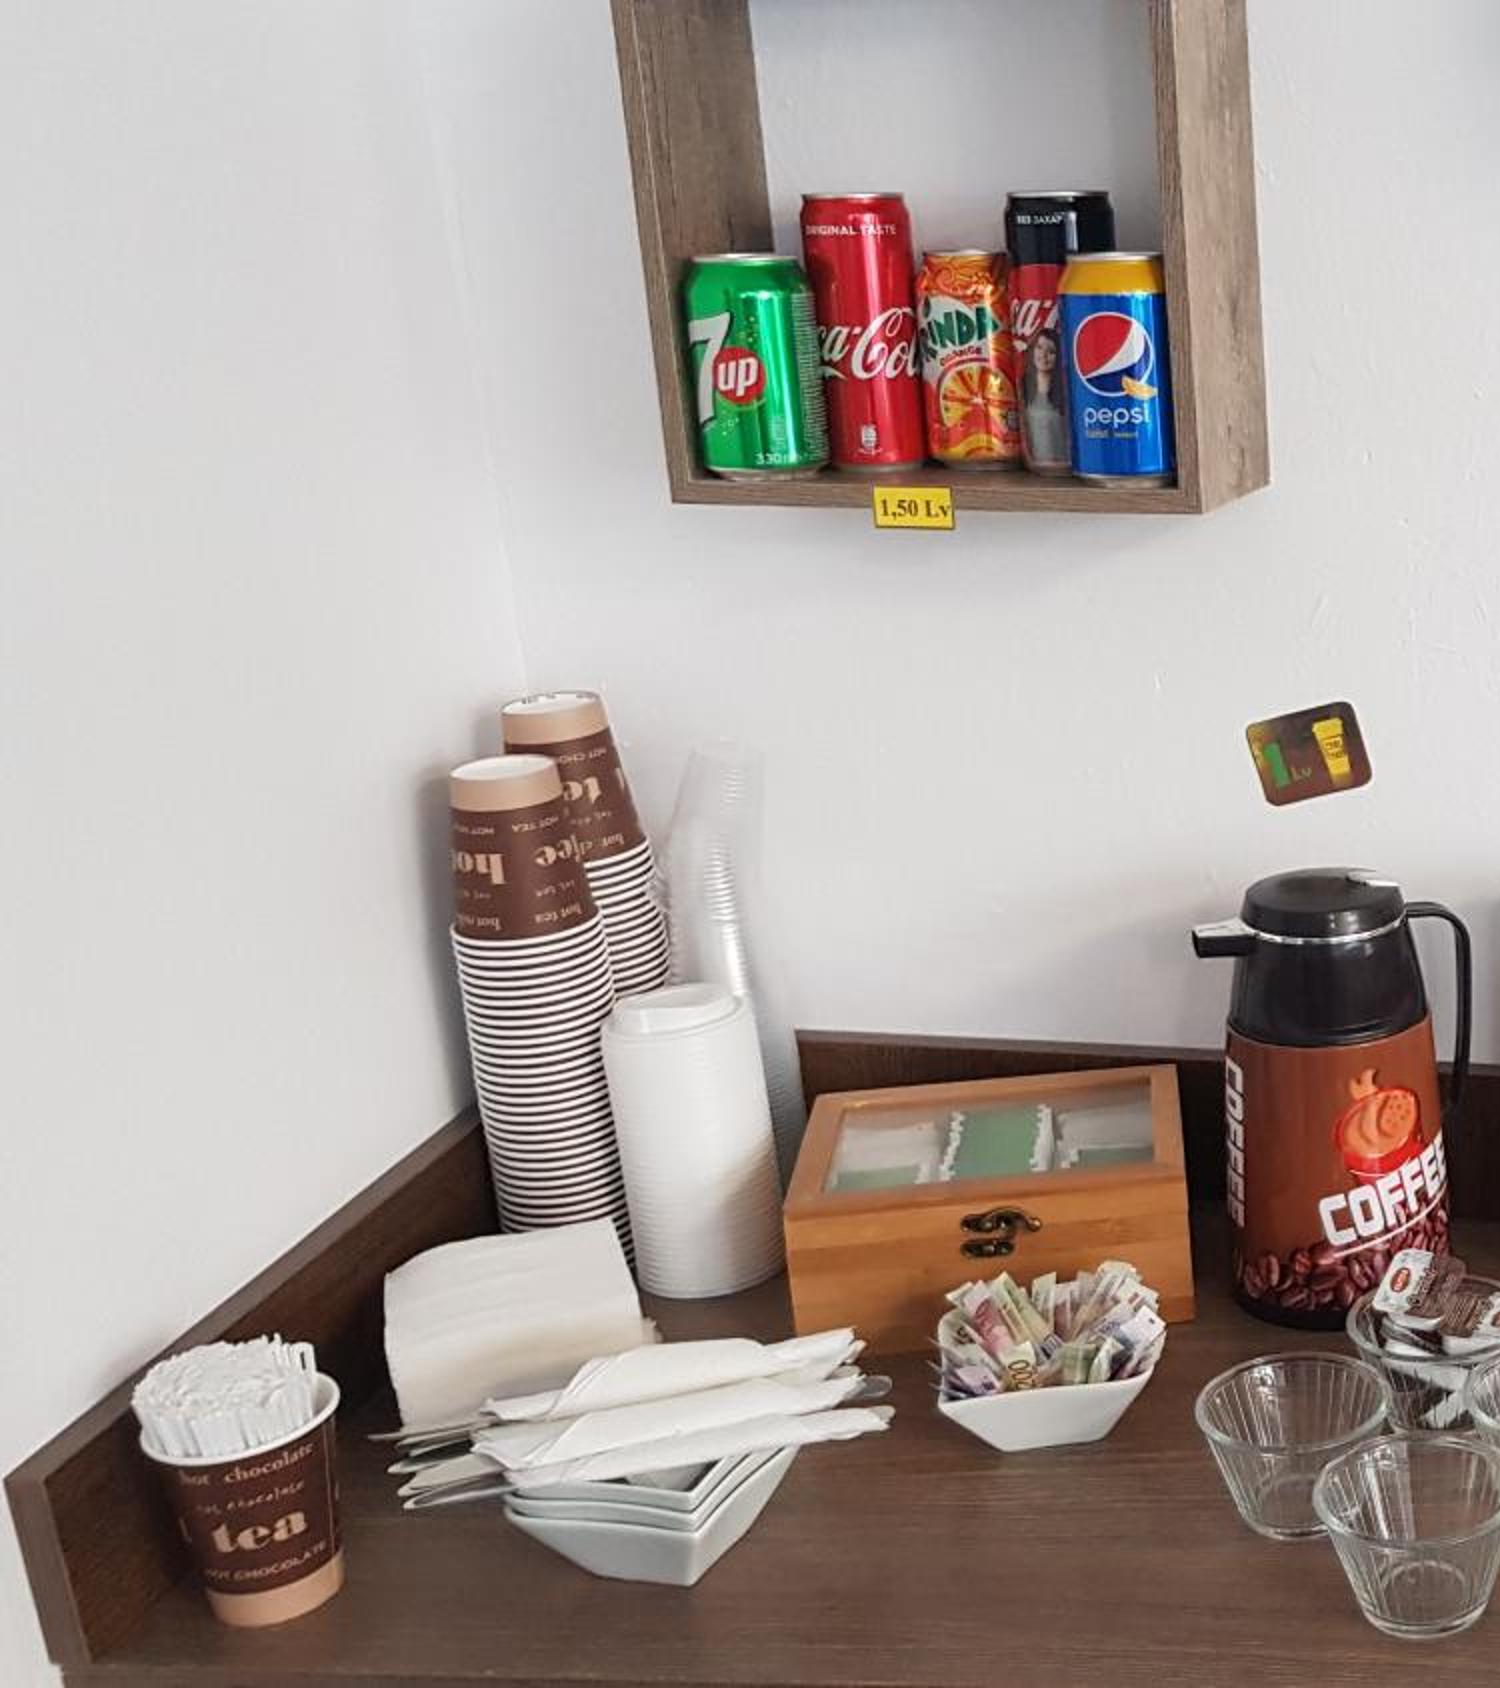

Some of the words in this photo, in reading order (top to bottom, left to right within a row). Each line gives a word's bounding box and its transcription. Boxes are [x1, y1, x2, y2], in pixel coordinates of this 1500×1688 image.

[806, 224, 856, 236] ORIGINAL
[861, 223, 896, 236] TASTE
[1084, 407, 1149, 428] pepsi
[881, 498, 919, 521] 1,50
[926, 499, 950, 518] Lv
[563, 777, 602, 805] te
[225, 1443, 314, 1483] chocolate
[212, 1512, 308, 1552] tea
[233, 1541, 327, 1581] CHOCOLATE
